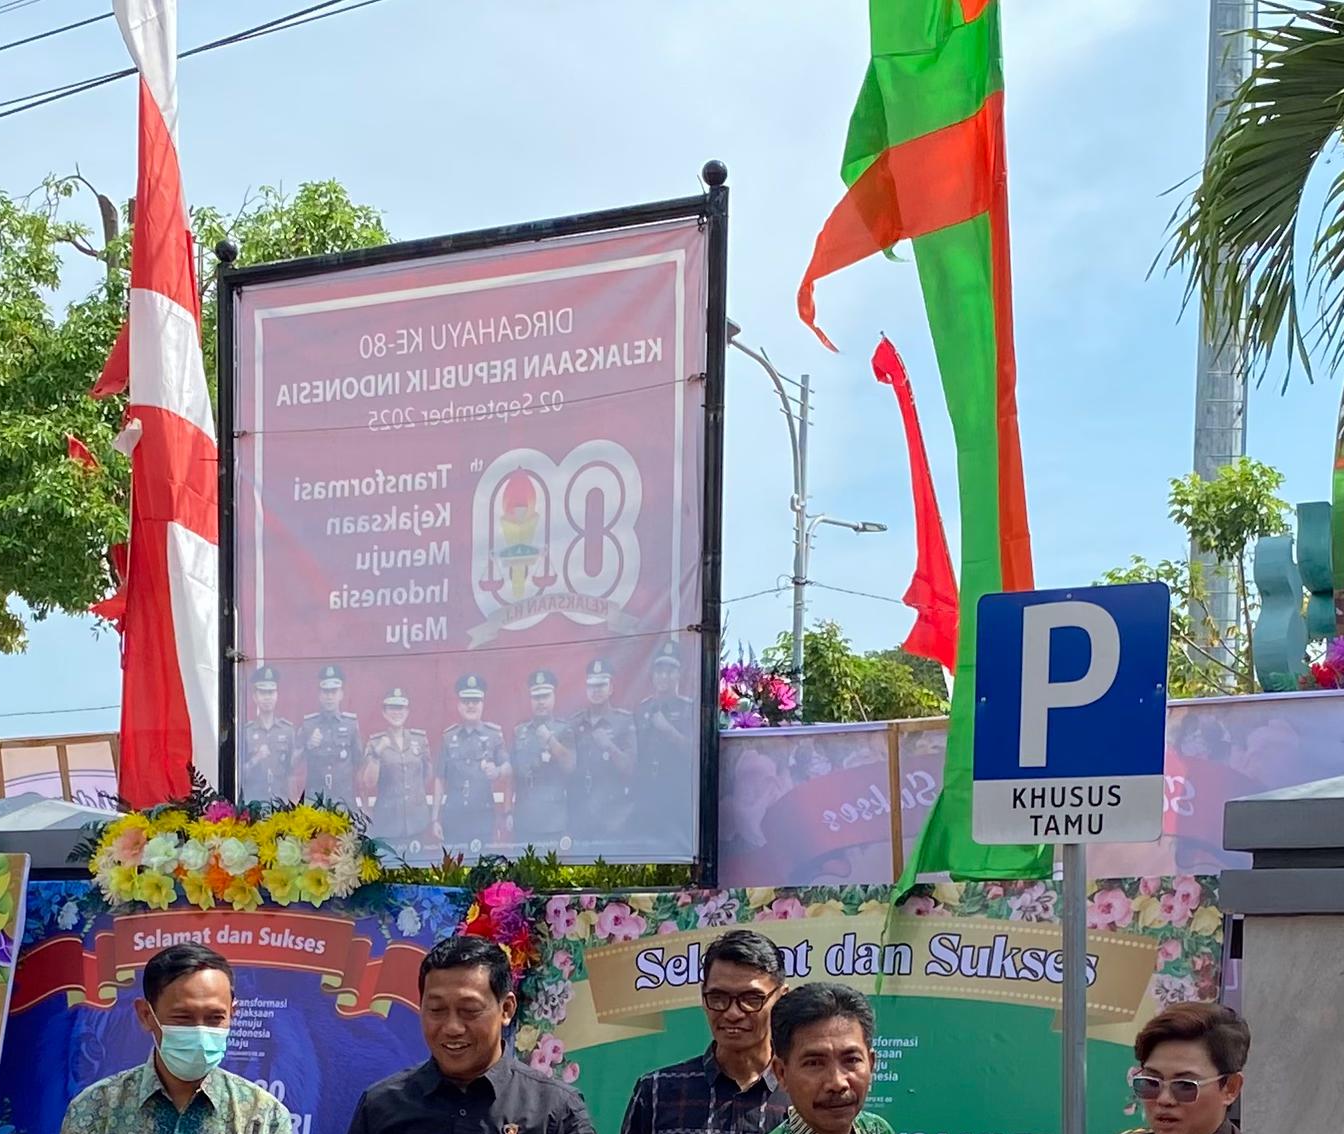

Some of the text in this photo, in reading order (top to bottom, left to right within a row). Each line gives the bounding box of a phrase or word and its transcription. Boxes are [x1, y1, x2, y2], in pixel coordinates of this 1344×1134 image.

[1018, 600, 1121, 769] P
[1011, 784, 1123, 811] KHUSUS
[1028, 812, 1105, 837] TAMU
[133, 924, 327, 955] Selamat dan Sukses
[635, 938, 812, 991] Selat
[824, 932, 913, 976] dan
[234, 1009, 275, 1021] ejaksaan
[871, 1035, 919, 1048] sformasi
